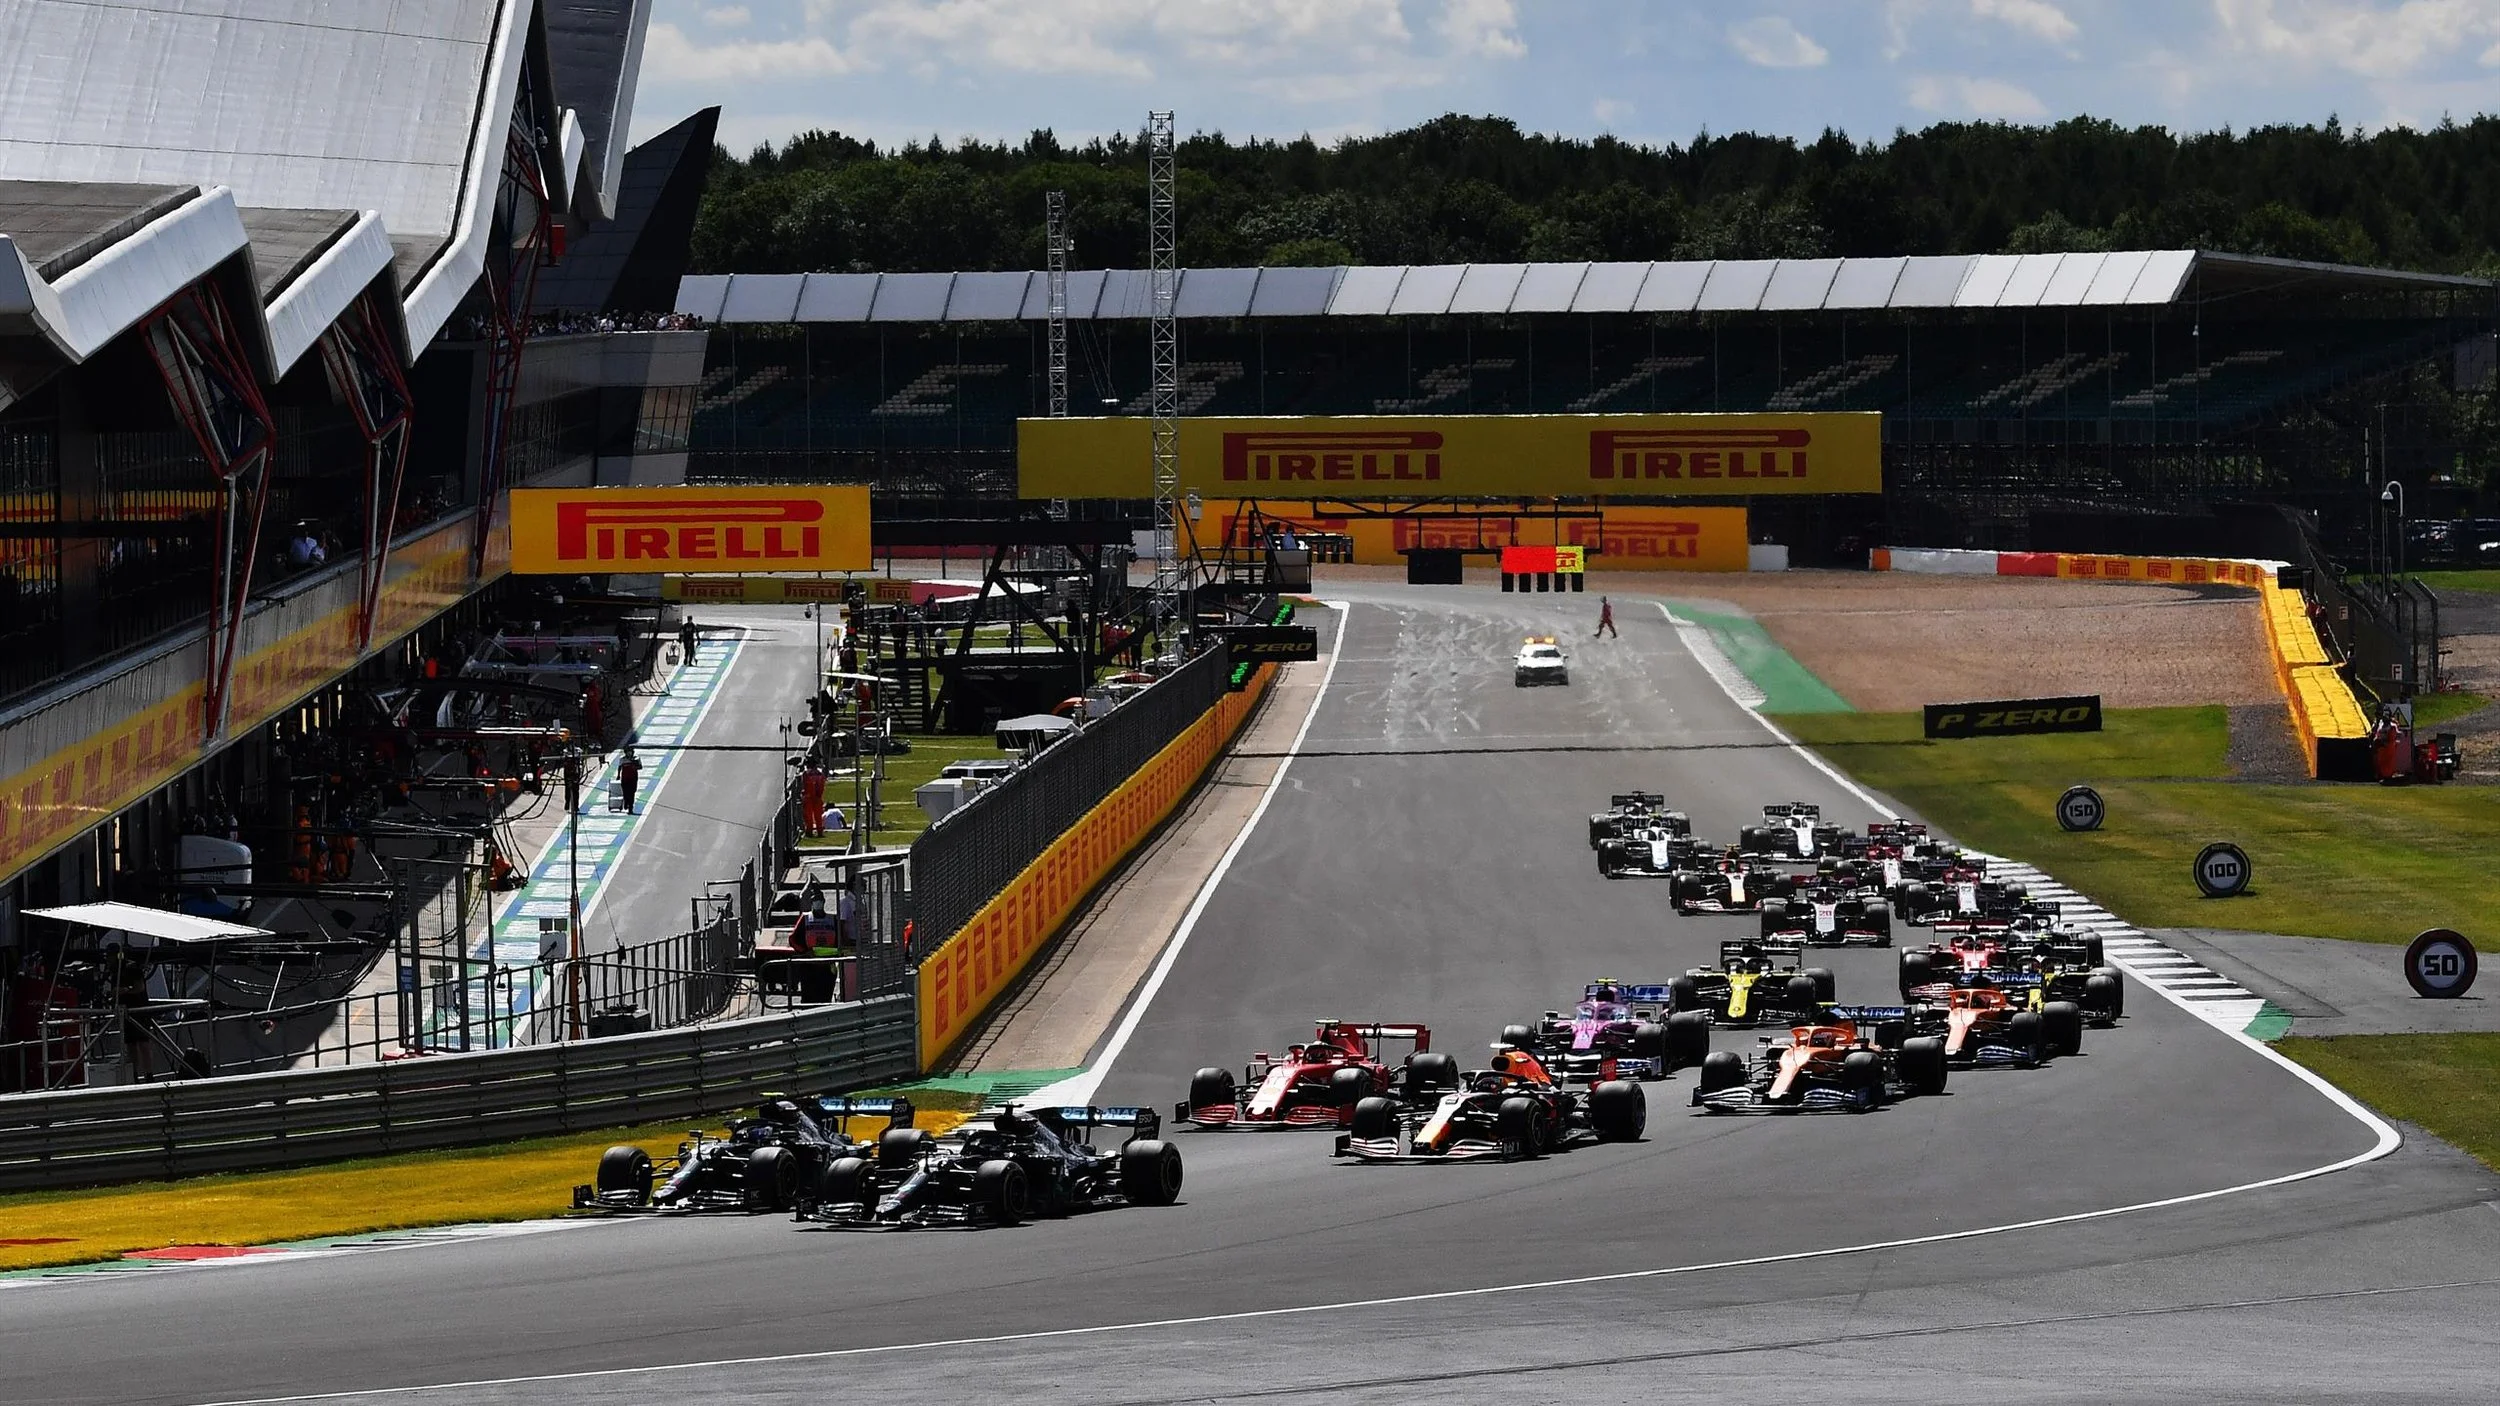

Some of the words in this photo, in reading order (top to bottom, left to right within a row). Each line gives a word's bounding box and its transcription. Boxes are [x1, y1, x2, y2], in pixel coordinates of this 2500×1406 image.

[1223, 431, 1443, 481] PIRELLI
[1590, 429, 1811, 479] PIRELLI
[557, 500, 824, 560] PIRELLI
[681, 581, 744, 597] PIRELLI
[1232, 644, 1248, 653] P
[1252, 643, 1312, 653] ZERO
[2393, 665, 2401, 679] F
[1938, 714, 1965, 730] P
[1974, 706, 2091, 728] ZERO
[2069, 804, 2094, 818] 150
[2208, 862, 2238, 879] 100
[2424, 954, 2459, 976] 50
